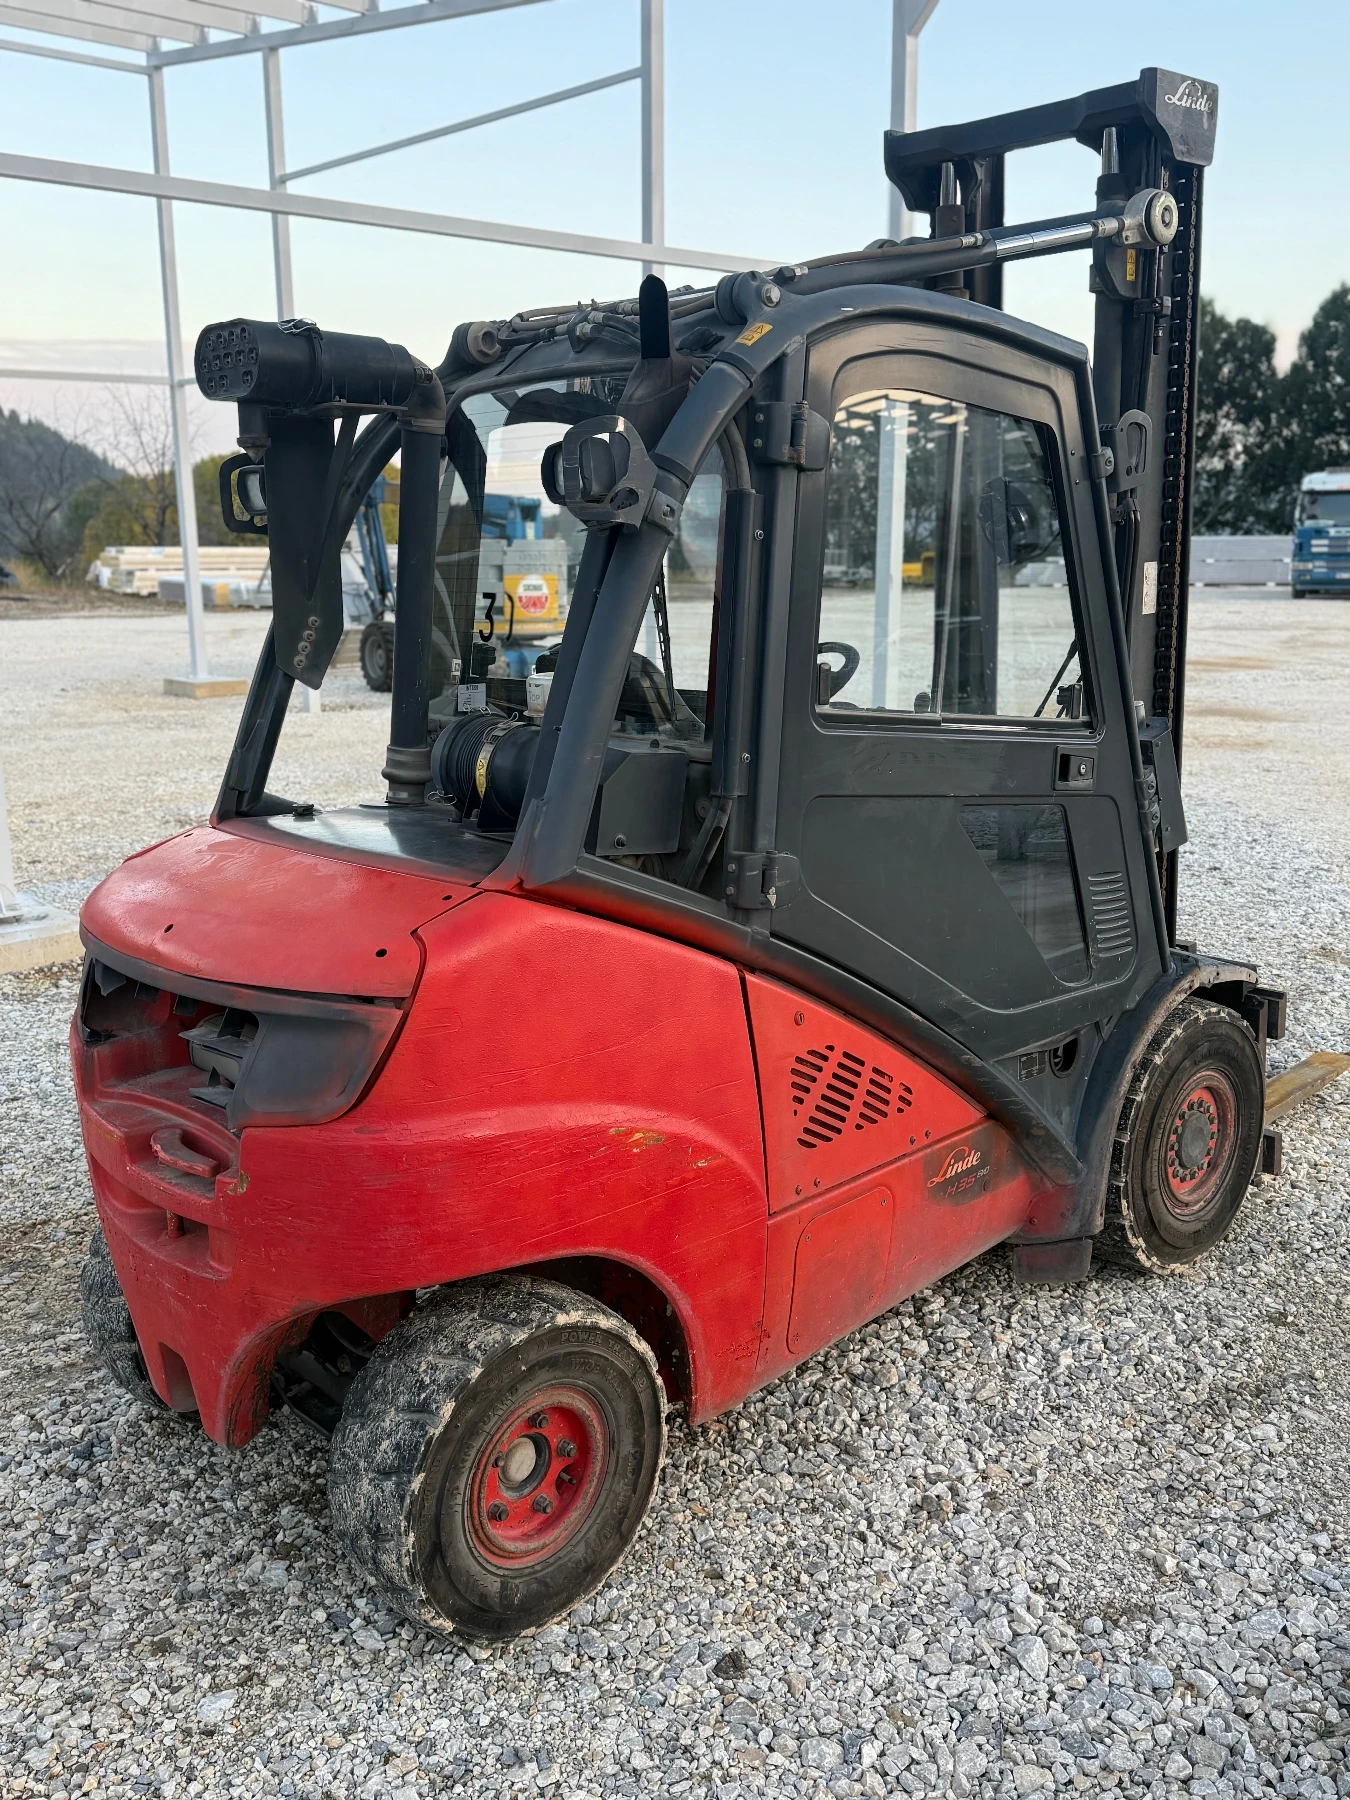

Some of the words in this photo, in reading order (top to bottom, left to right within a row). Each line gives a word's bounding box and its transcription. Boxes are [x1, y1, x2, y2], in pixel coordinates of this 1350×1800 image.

[1165, 80, 1212, 112] Linde
[927, 1146, 981, 1188] Linde
[561, 1331, 602, 1344] POWER
